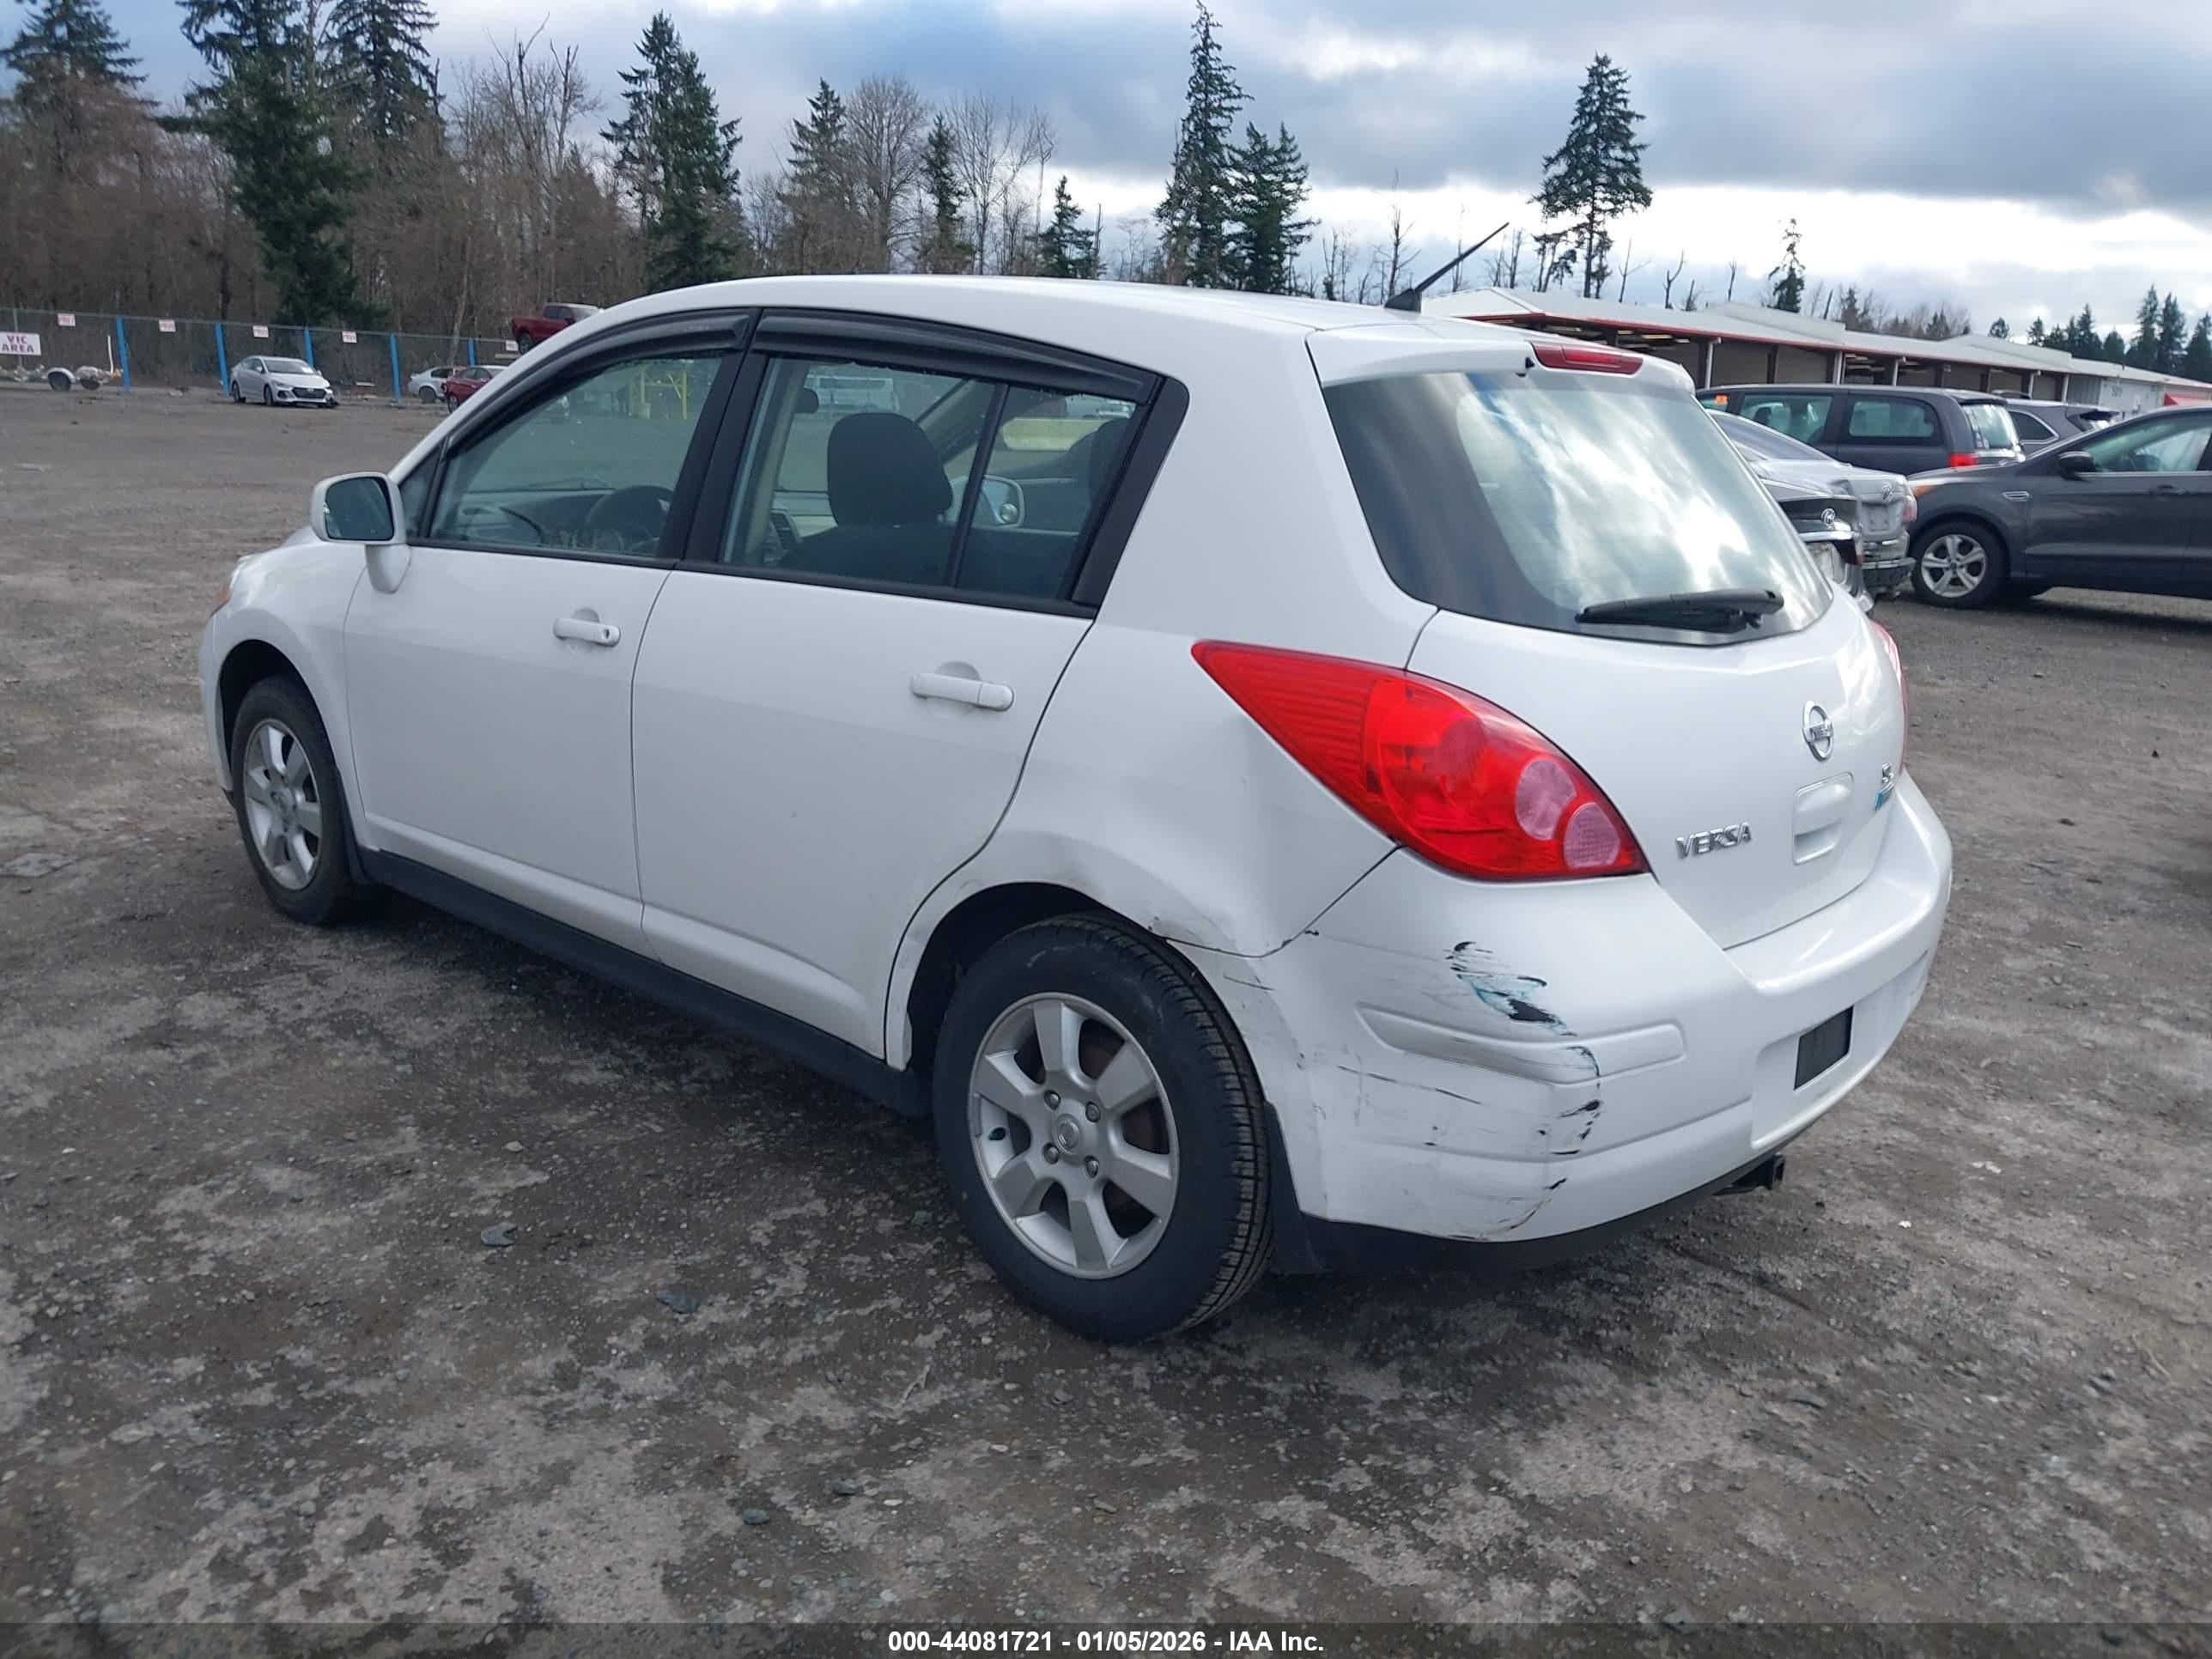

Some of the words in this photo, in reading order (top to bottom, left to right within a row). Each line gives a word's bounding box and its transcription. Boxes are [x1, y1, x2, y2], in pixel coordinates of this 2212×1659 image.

[7, 335, 27, 343] VIC
[2, 343, 34, 353] AREA
[1675, 822, 1752, 860] VERSA
